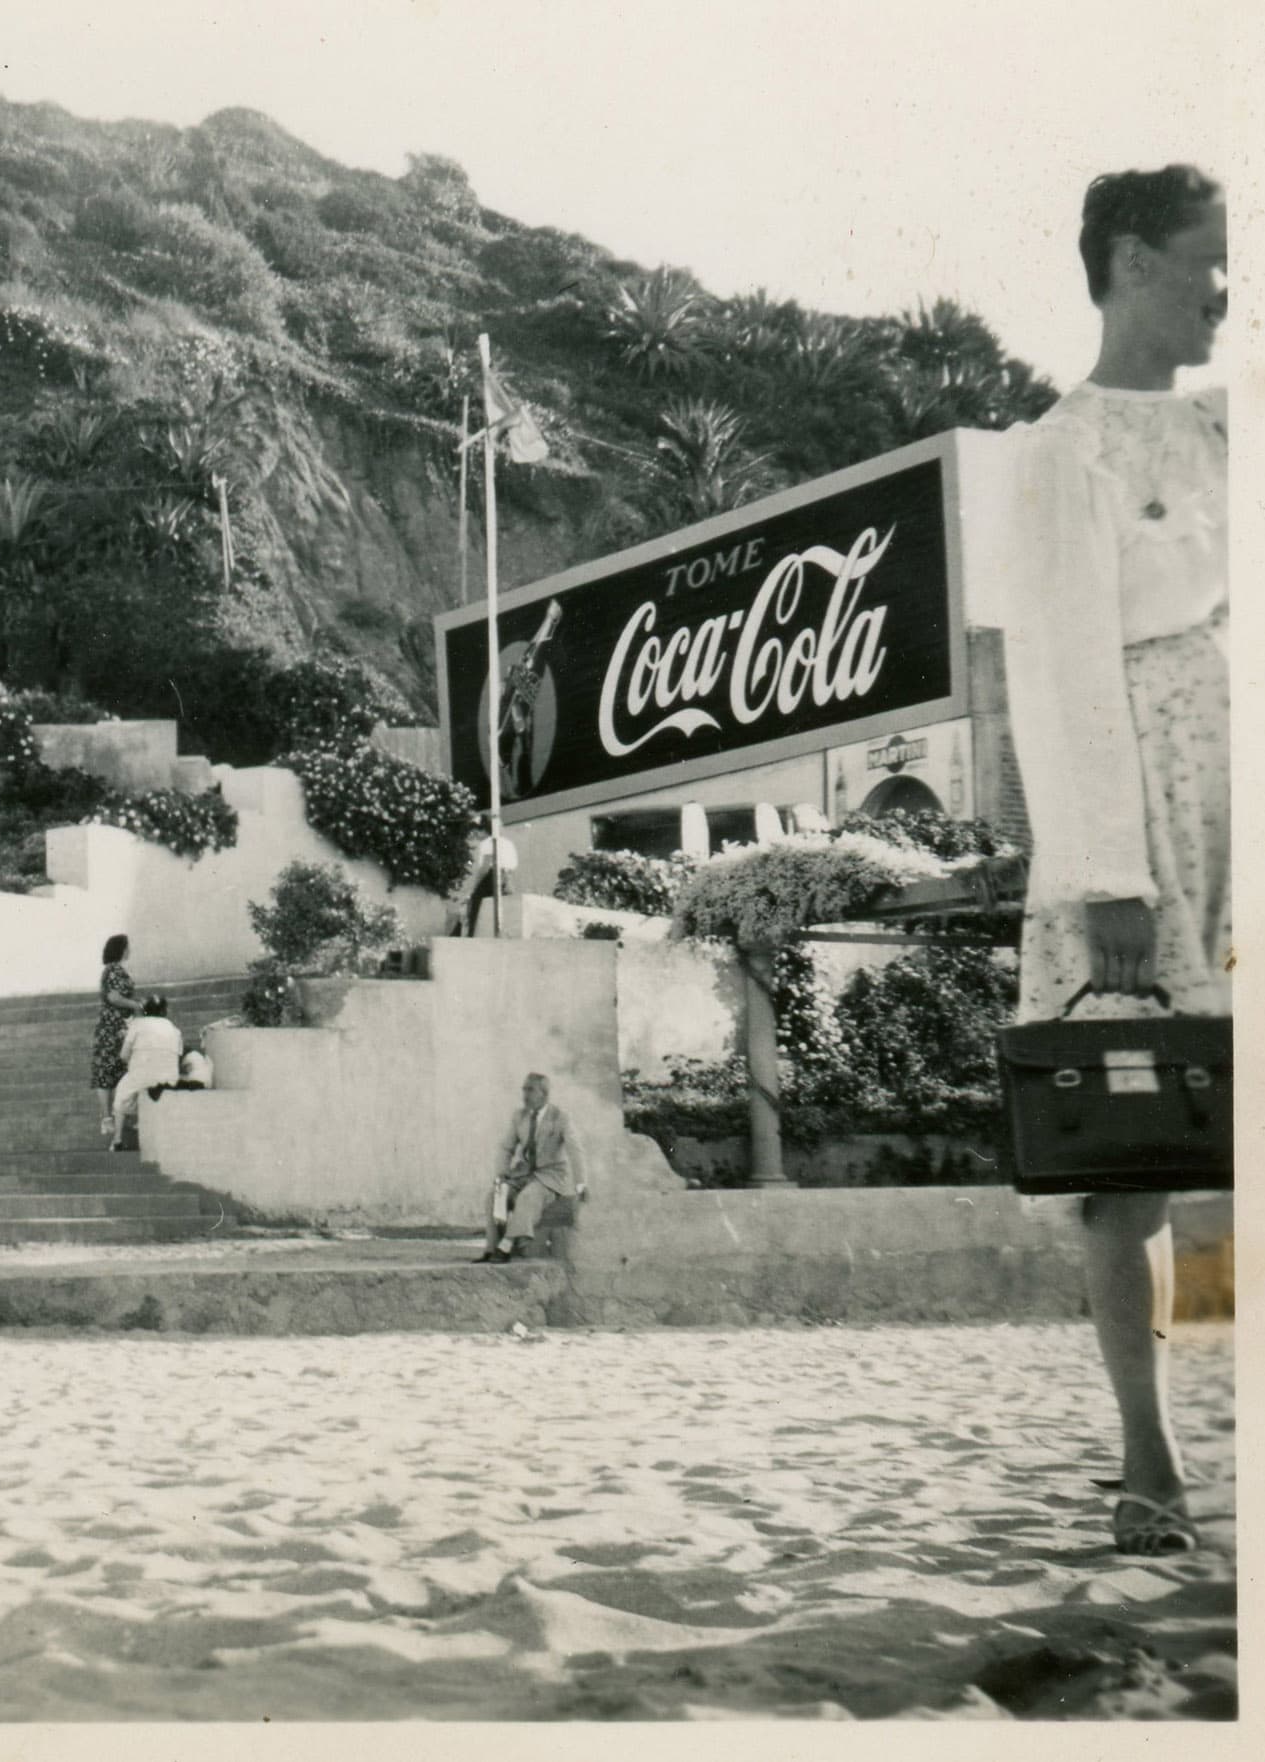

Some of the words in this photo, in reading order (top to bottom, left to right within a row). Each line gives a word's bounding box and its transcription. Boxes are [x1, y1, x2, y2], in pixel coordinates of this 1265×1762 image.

[664, 537, 766, 597] TOME
[598, 521, 898, 758] Coca-Cola
[868, 740, 927, 768] MARTINI
